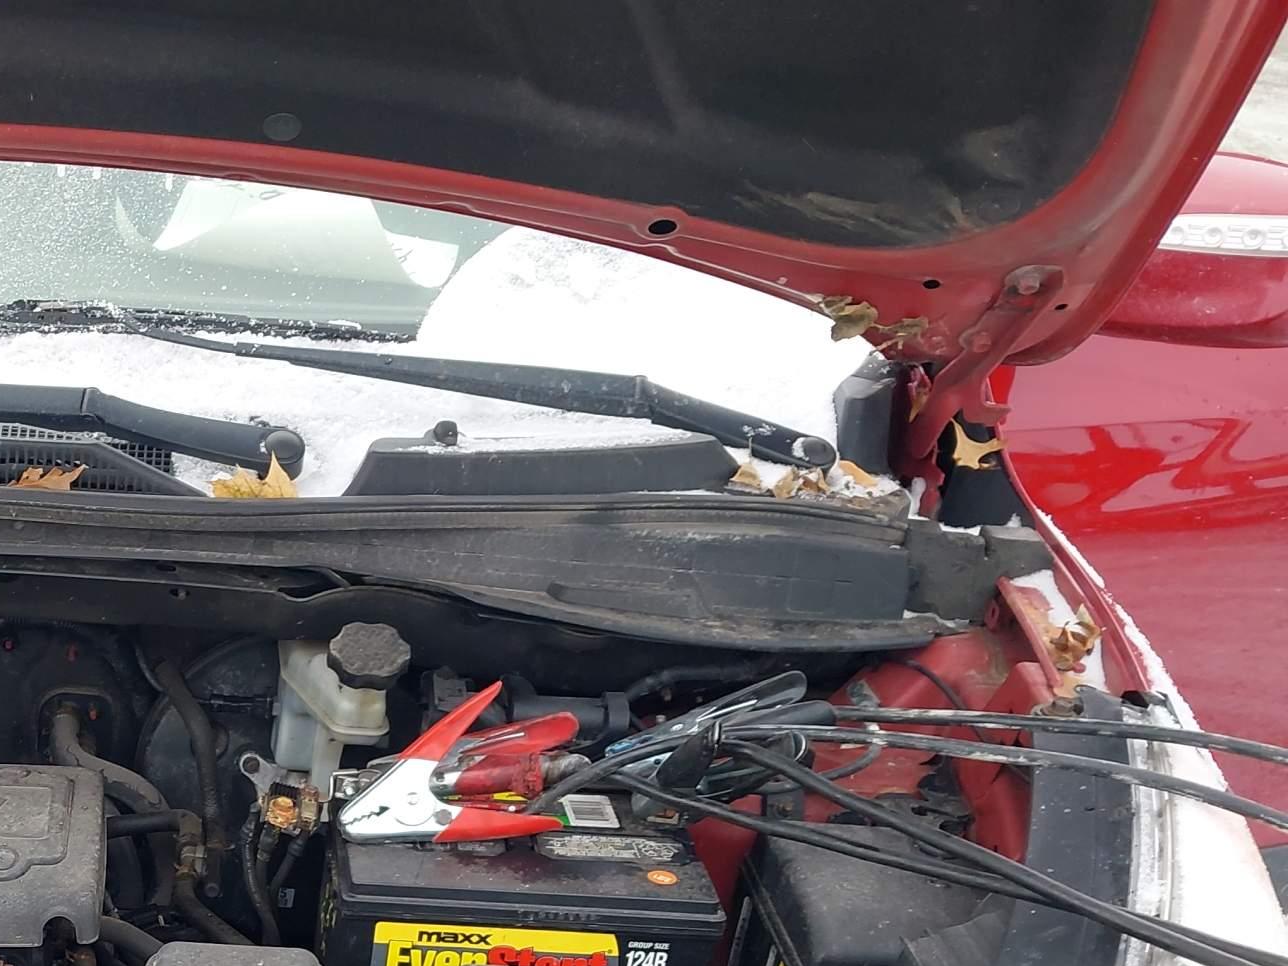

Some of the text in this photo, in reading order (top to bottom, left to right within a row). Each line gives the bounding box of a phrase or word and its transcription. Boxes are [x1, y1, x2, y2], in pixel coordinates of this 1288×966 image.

[417, 930, 494, 946] maxx
[627, 941, 671, 950] GROUP SIZE
